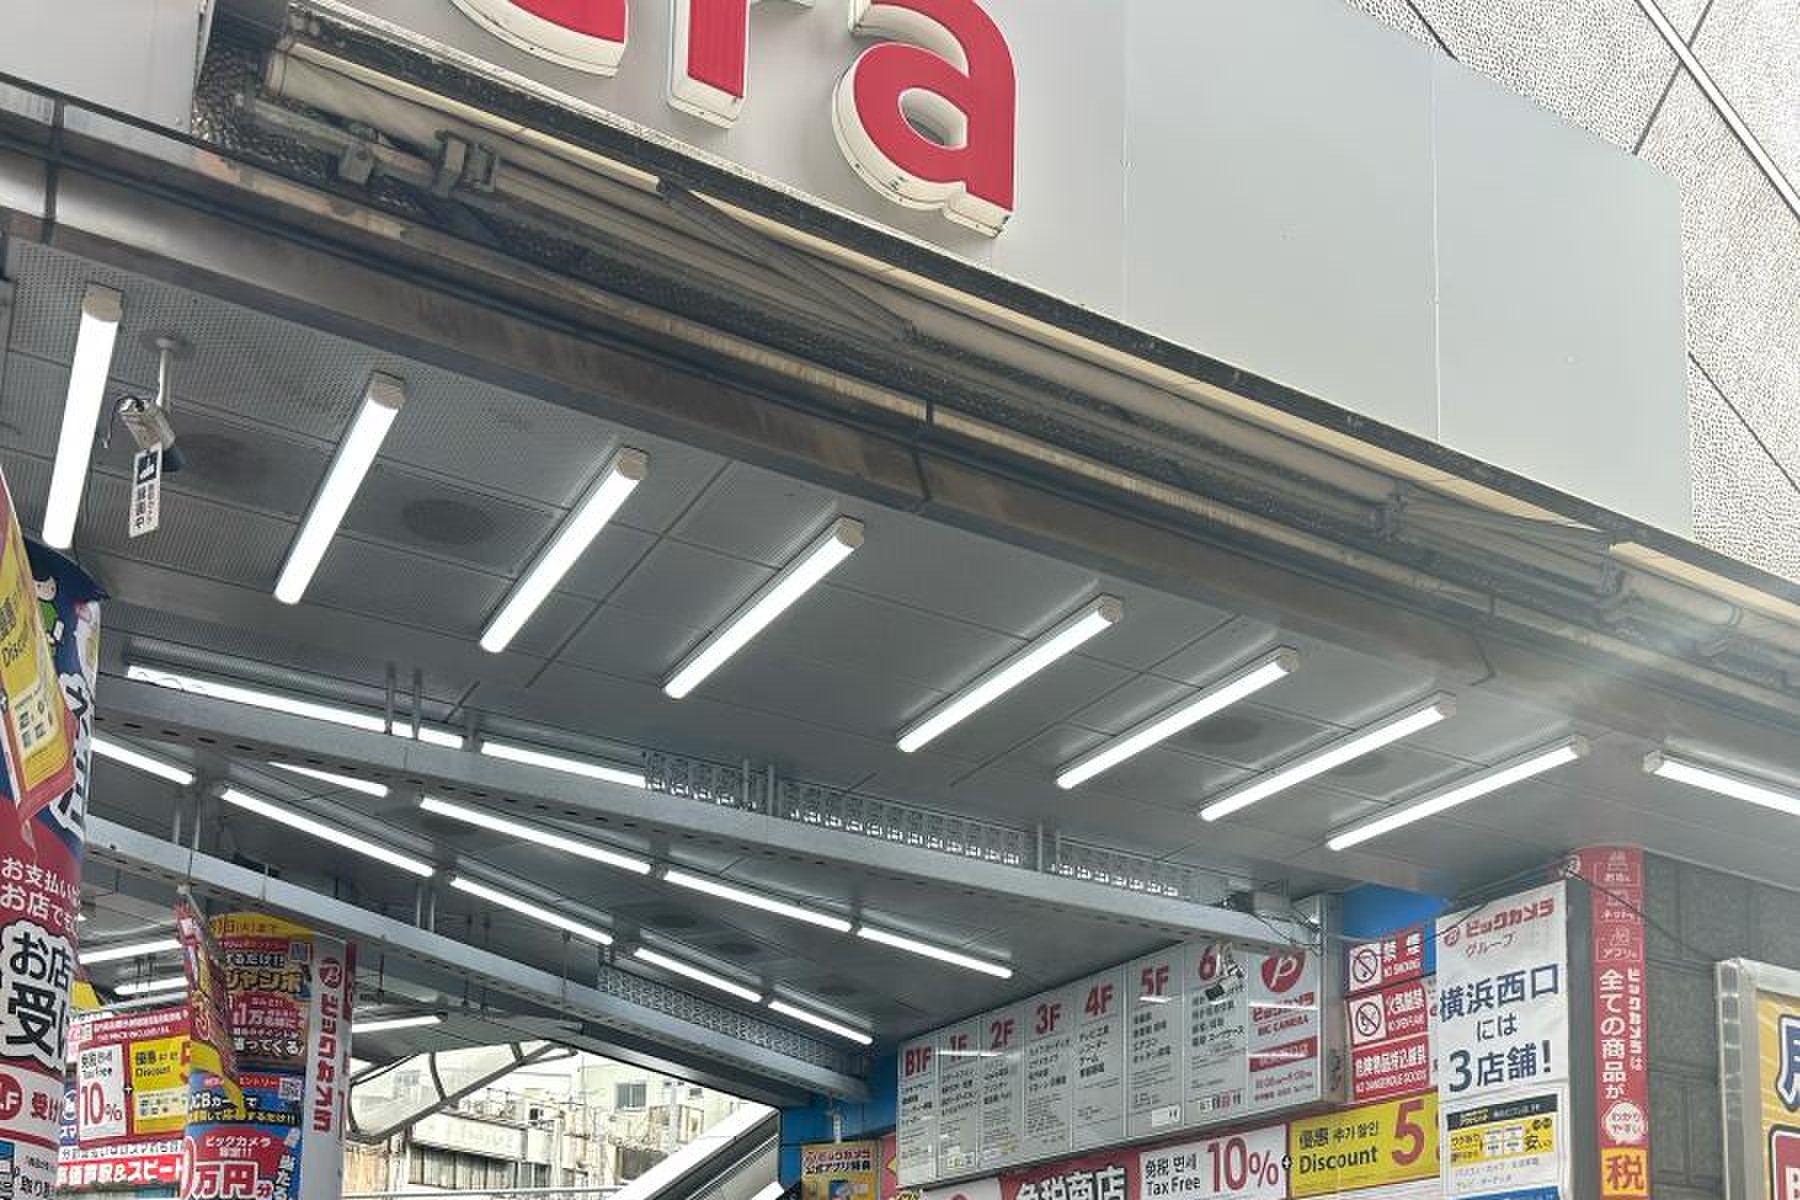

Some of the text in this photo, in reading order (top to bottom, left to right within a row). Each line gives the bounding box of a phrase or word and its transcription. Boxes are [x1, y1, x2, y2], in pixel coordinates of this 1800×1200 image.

[1465, 897, 1555, 937] ビックカメラ
[1465, 933, 1515, 958] グループ
[1141, 965, 1169, 996] 5F
[1440, 963, 1560, 1022] 横浜西口
[1085, 984, 1113, 1016] 4F
[991, 1019, 1014, 1049] 2F
[1036, 1003, 1061, 1035] 3F
[1476, 1013, 1519, 1041] には
[1600, 968, 1627, 1099] 全ての商品が
[1627, 967, 1646, 1071] ビックカメラは
[905, 1048, 931, 1077] B1F
[949, 1034, 968, 1063] 1F
[1449, 1040, 1552, 1092] 3店舗!
[81, 1082, 123, 1125] 10%
[205, 1135, 272, 1147] ビックカメラ
[1207, 1137, 1280, 1193] 10%
[1299, 1146, 1378, 1175] Discount
[1146, 1176, 1201, 1196] Tax Free
